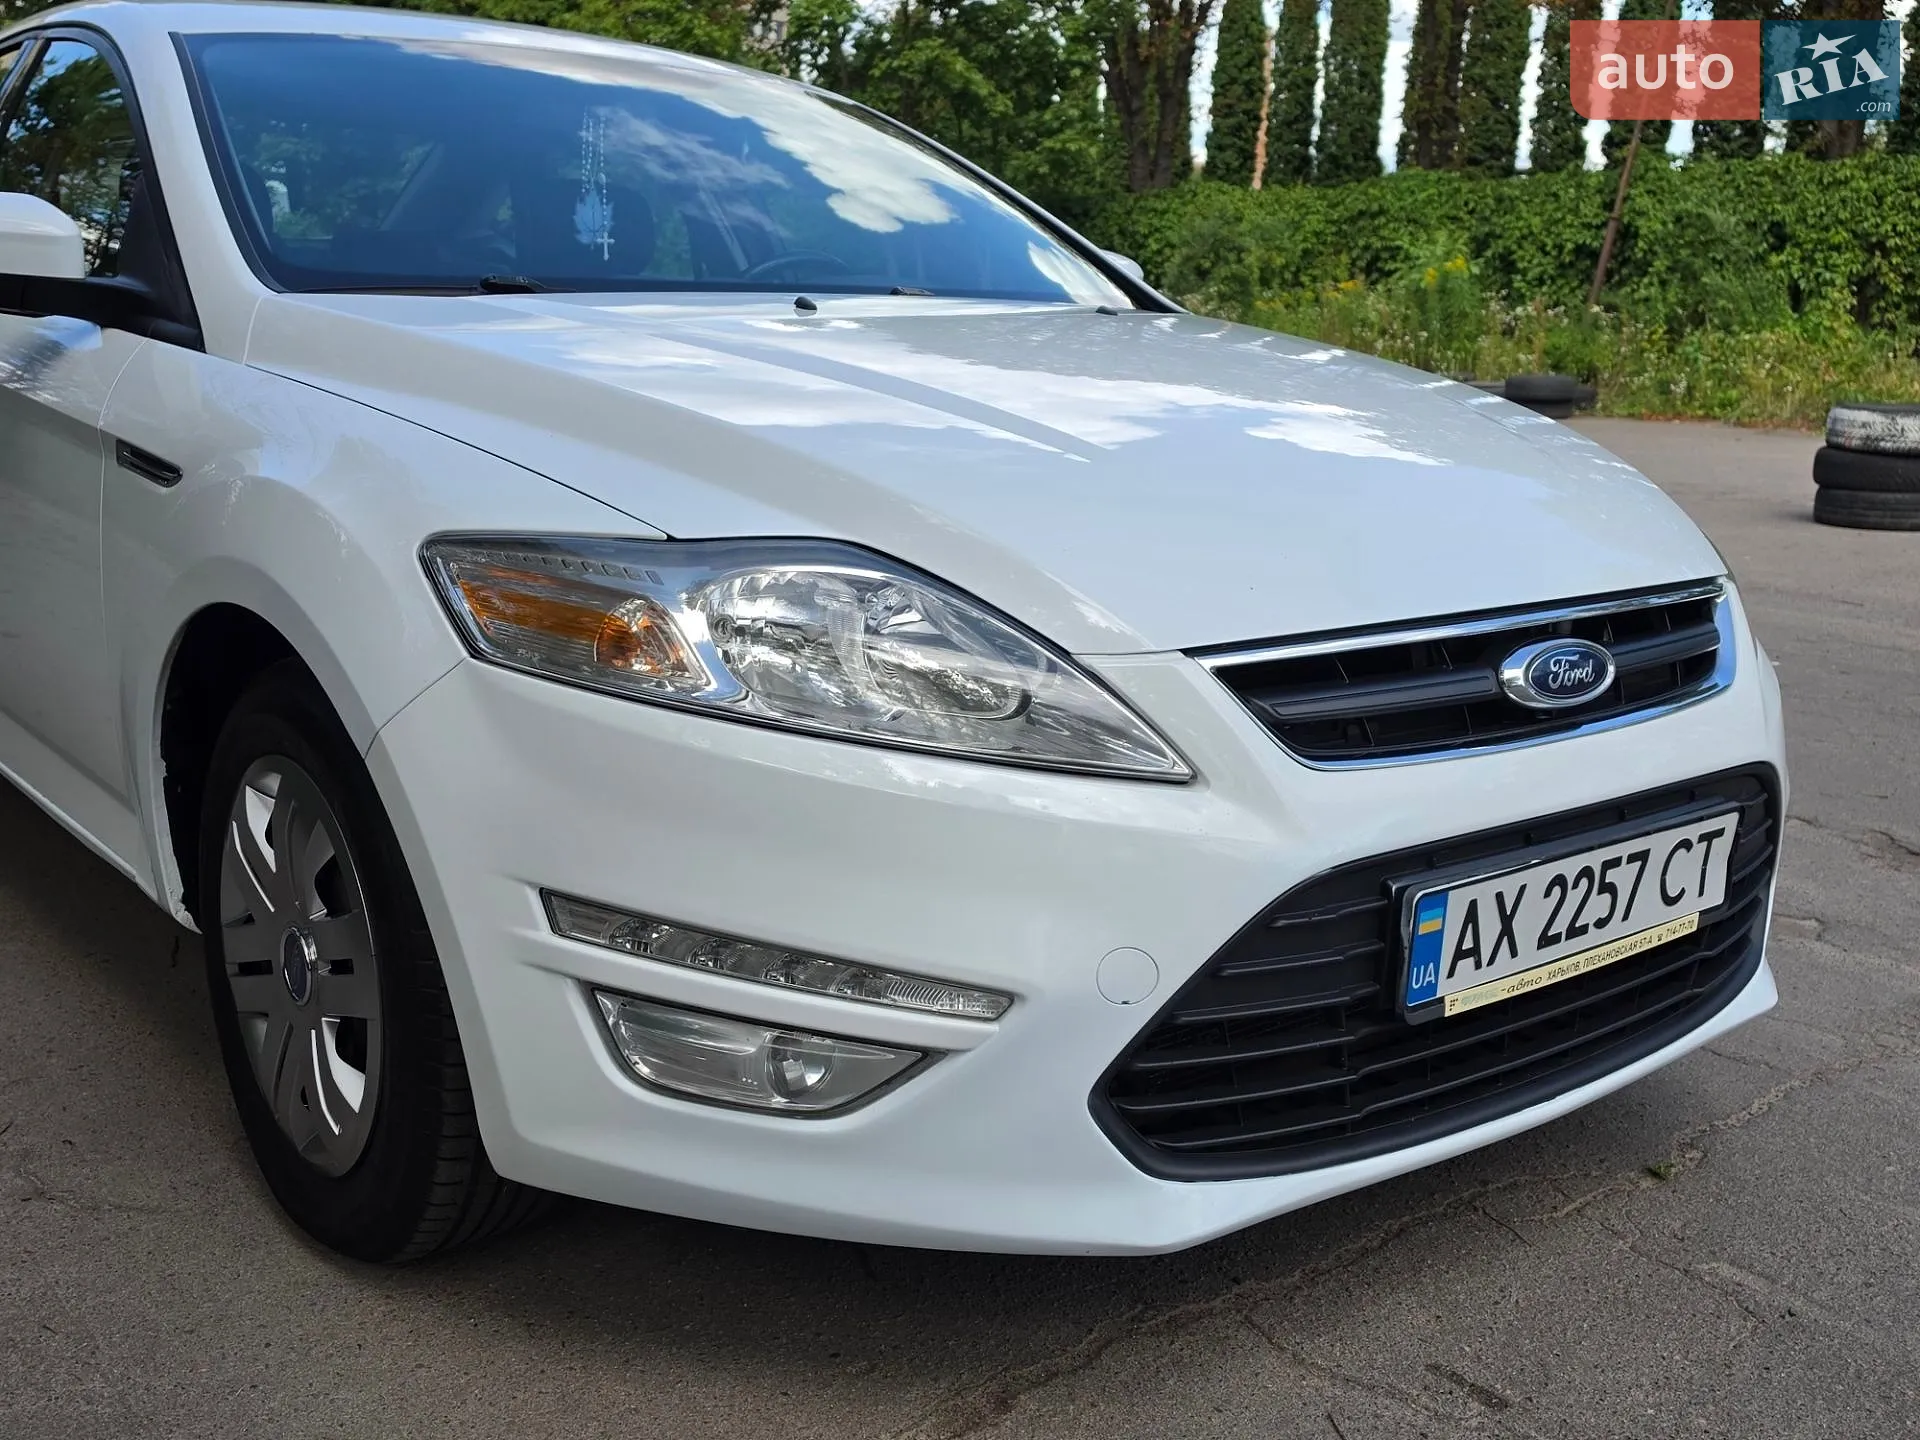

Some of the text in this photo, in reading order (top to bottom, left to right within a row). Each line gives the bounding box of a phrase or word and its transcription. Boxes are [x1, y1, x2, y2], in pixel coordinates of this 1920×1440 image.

[1548, 654, 1596, 690] Ford
[1446, 826, 1726, 979] AX 2257 CT
[1411, 962, 1436, 990] UA
